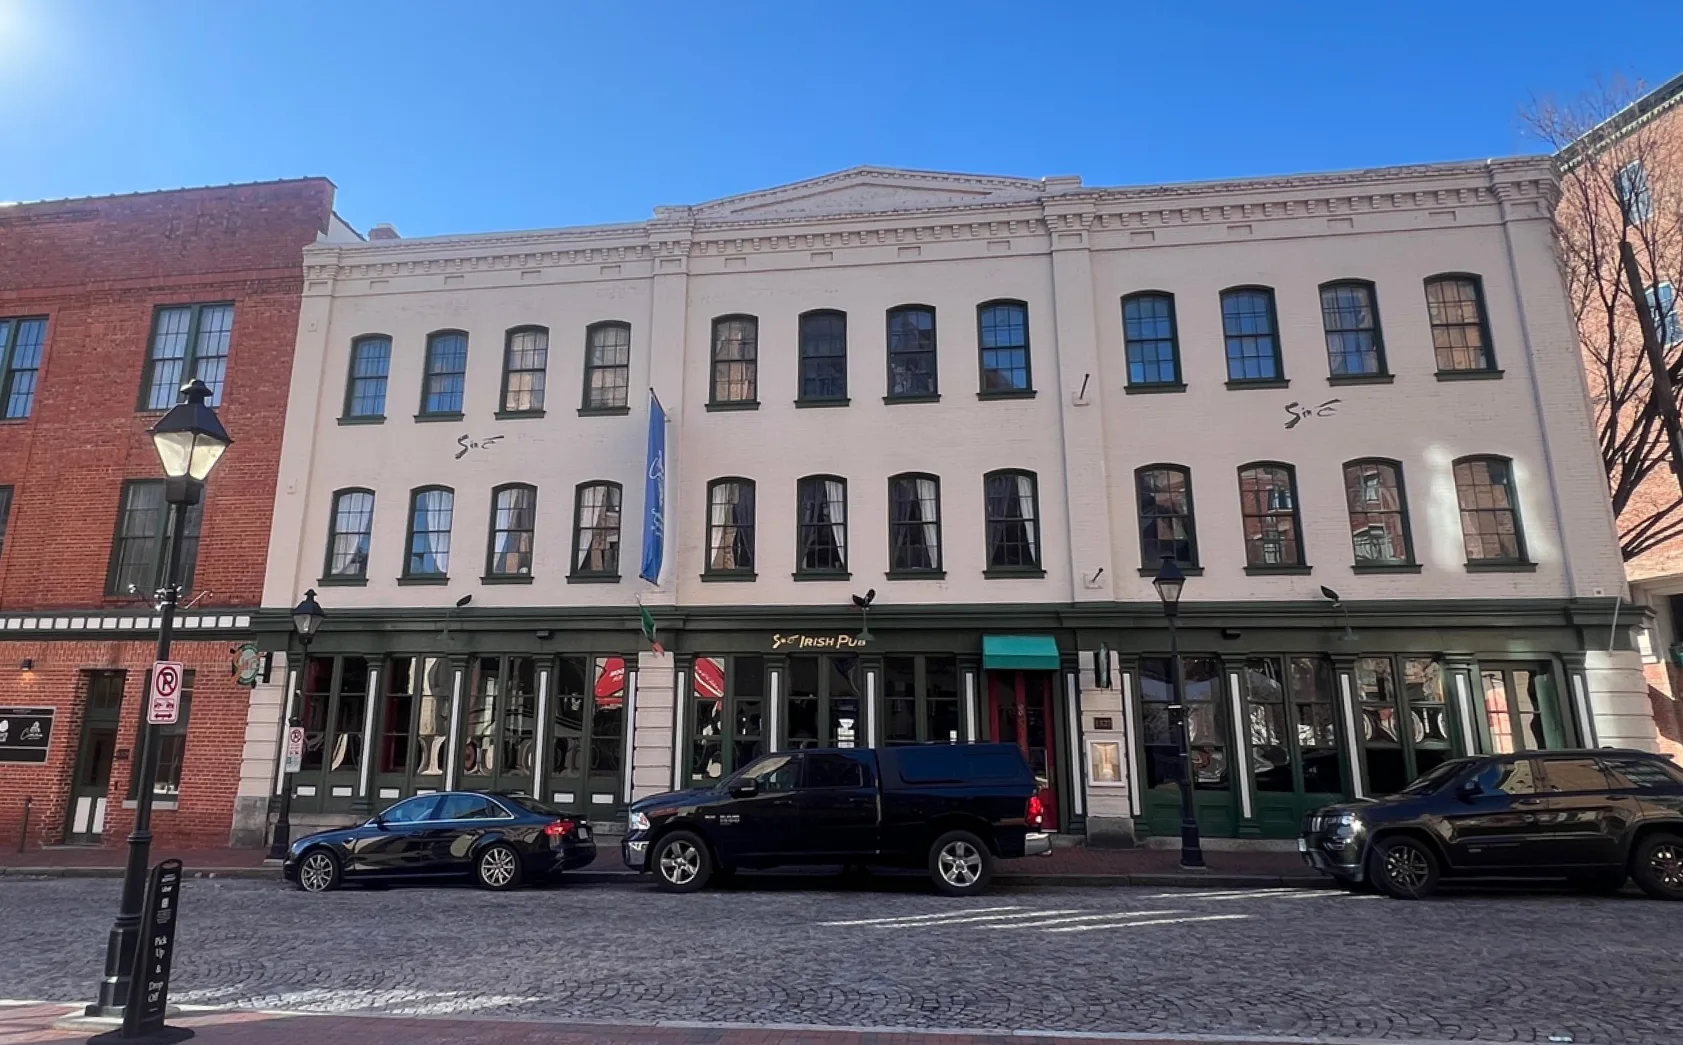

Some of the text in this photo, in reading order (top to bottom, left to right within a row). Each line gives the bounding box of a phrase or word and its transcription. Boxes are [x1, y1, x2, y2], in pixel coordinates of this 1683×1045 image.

[799, 635, 834, 648] IRISH
[155, 935, 167, 946] Pick
[155, 948, 165, 959] Up
